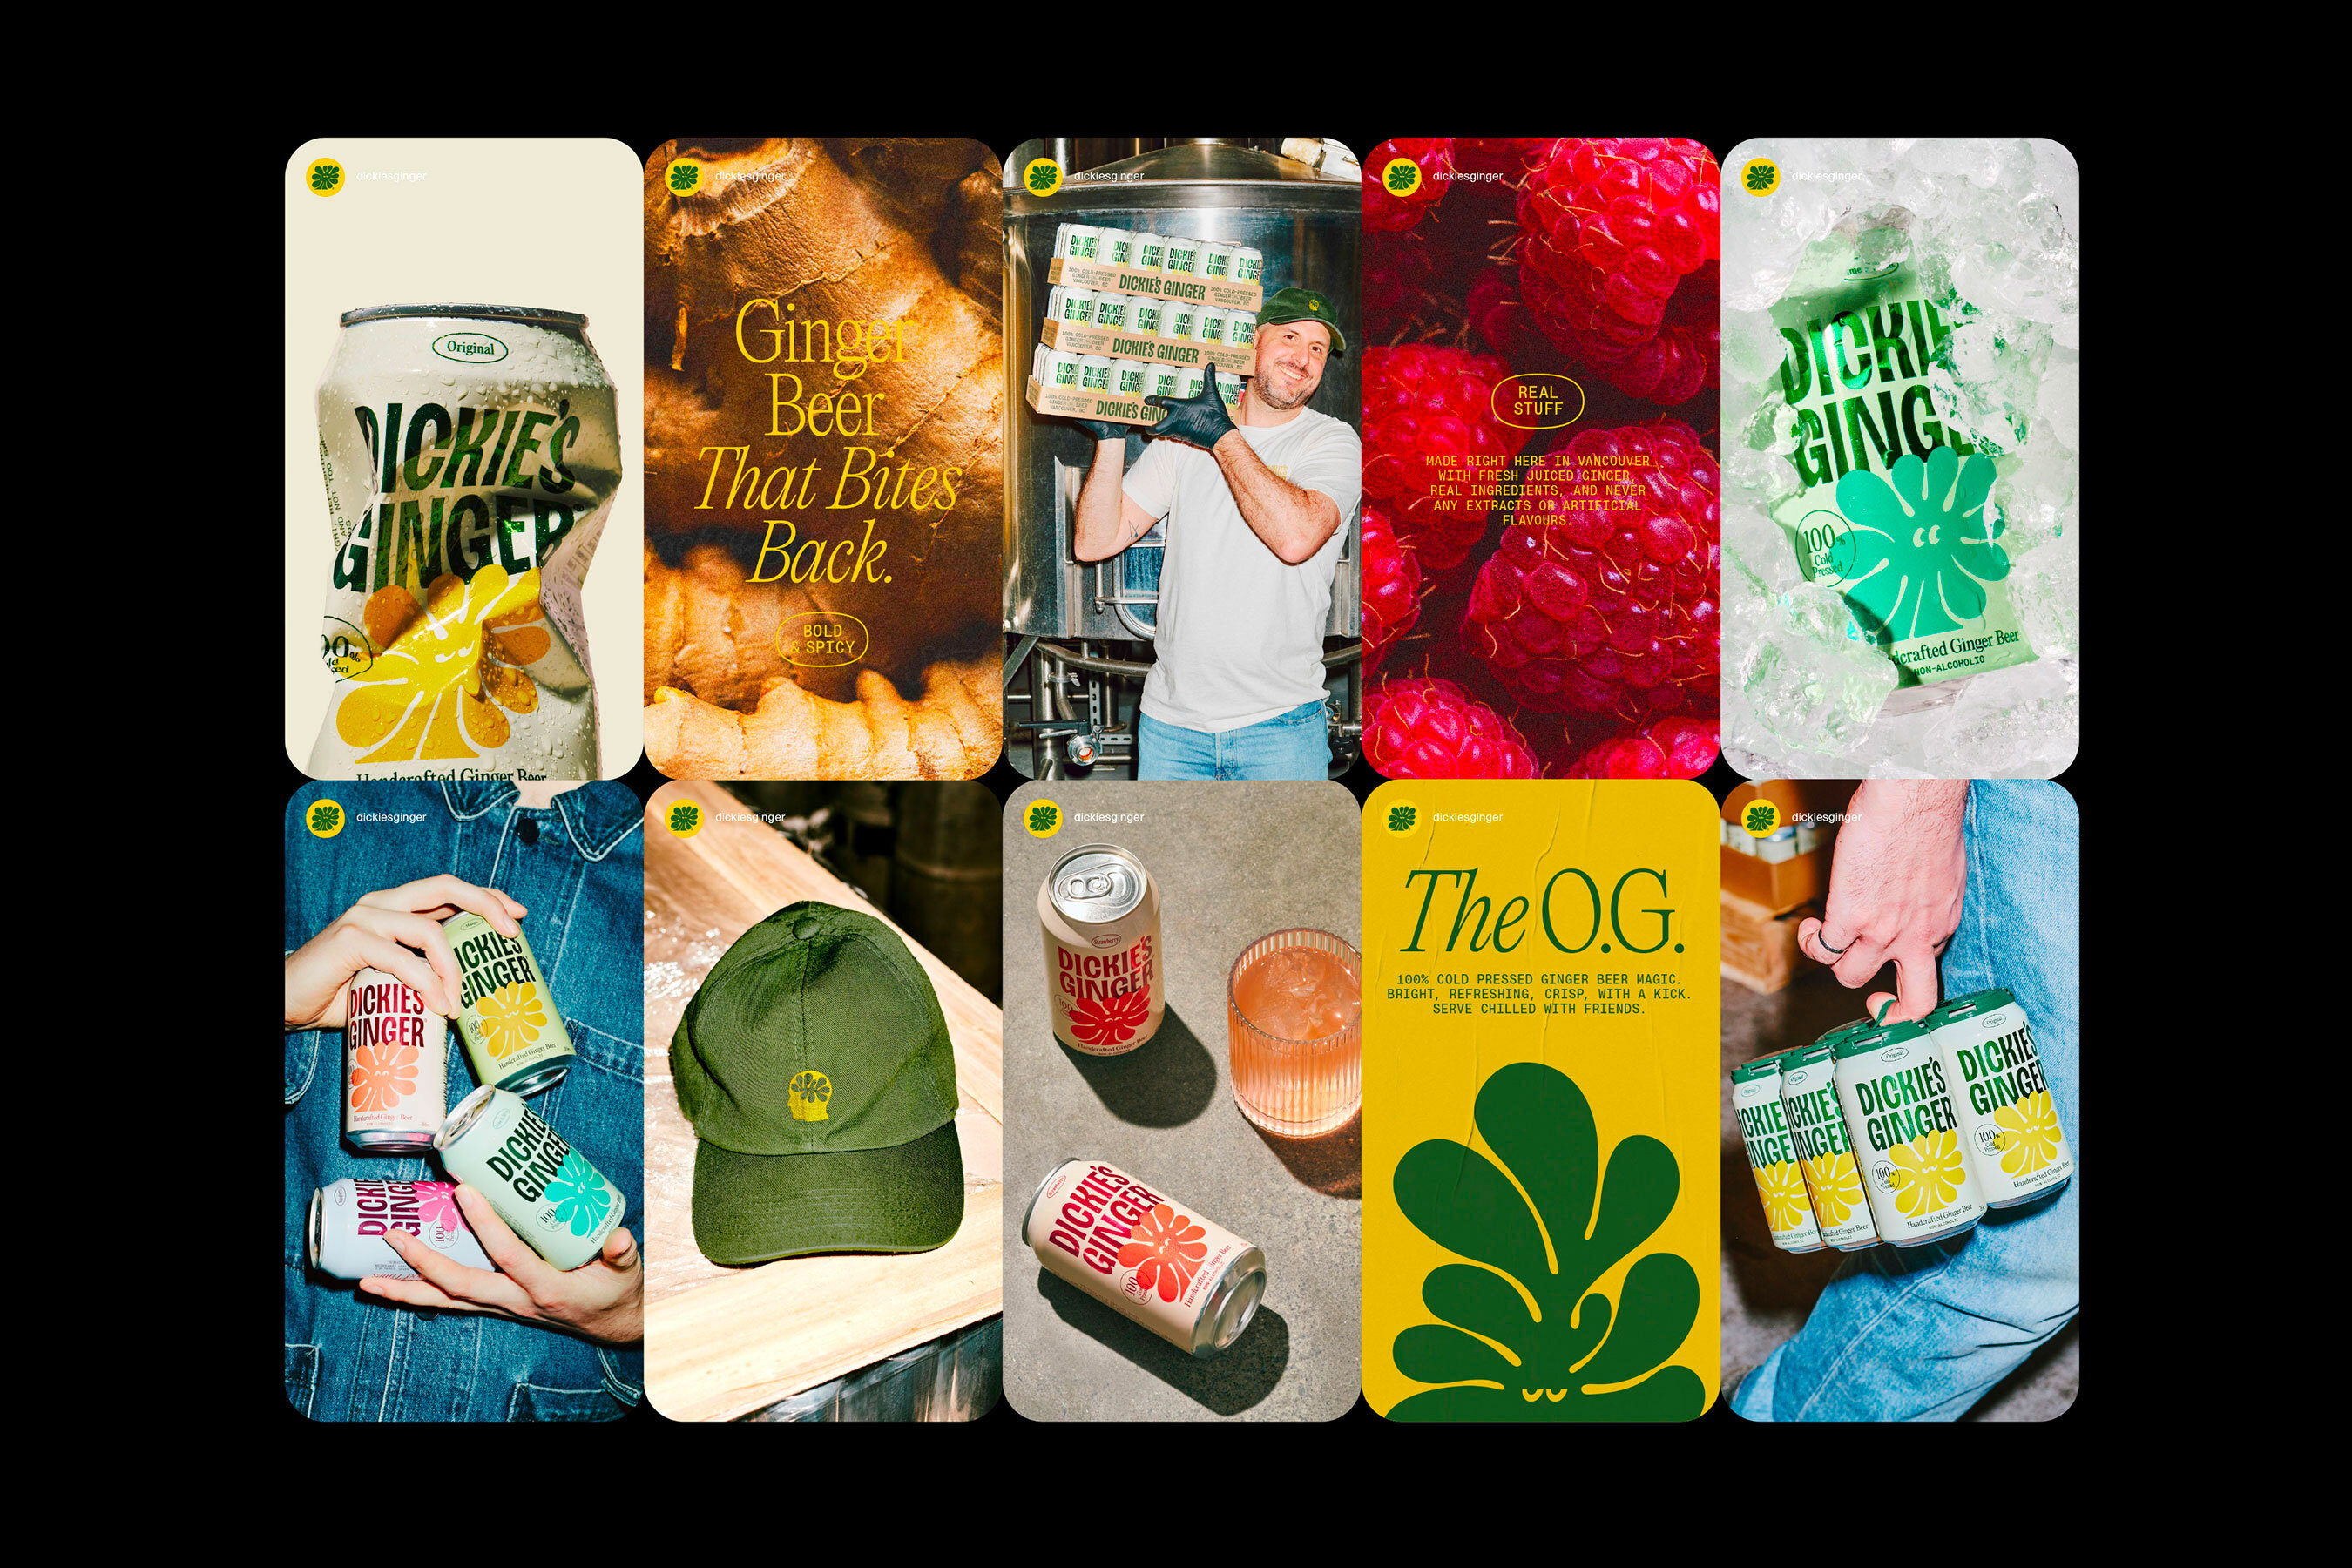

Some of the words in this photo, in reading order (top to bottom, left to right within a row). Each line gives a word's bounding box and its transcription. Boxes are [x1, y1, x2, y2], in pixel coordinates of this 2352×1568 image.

[1119, 274, 1162, 294] DICKIE'S
[1164, 280, 1206, 301] GINGER
[447, 340, 496, 356] Original
[1112, 338, 1155, 358] DICKIE'S
[1157, 344, 1200, 363] GINGER
[1096, 400, 1139, 419] DICKIE'S
[354, 399, 580, 494] DICKIE'S
[1803, 524, 1846, 555] 100%
[1812, 560, 1843, 578] Pressed
[1814, 551, 1834, 566] Cold
[1888, 641, 1949, 666] dcrafted
[1950, 638, 1994, 653] Ginger
[1994, 629, 2019, 645] Beer
[1914, 655, 1985, 677] NON-ALCOHOLIC
[1399, 867, 1530, 954] The
[1542, 868, 1685, 954] O.G.
[1093, 936, 1119, 945] Strawberry
[1057, 935, 1152, 979] DICKIE'S
[460, 956, 537, 1010] GINGER
[1059, 959, 1154, 1002] GINGER
[1387, 988, 1439, 1001] BRIGHT,
[1449, 988, 1534, 1001] REFRESHING,
[1544, 988, 1589, 1001] CRISP,
[1598, 988, 1630, 1001] WITH
[1638, 988, 1646, 1001] A
[1653, 988, 1692, 1001] KICK.
[1396, 974, 1429, 985] 100%
[1437, 974, 1469, 985] COLD
[1477, 974, 1533, 985] PRESSED
[1541, 974, 1589, 985] GINGER
[1597, 974, 1628, 985] BEER
[1637, 974, 1681, 985] MAGIC.
[350, 983, 425, 1019] DICKIES
[1433, 1003, 1472, 1014] SERVE
[1481, 1003, 1536, 1014] CHILLED
[1544, 1003, 1576, 1014] WITH
[1584, 1003, 1646, 1014] FRIENDS.
[349, 1017, 425, 1051] GINGER
[1078, 1043, 1115, 1052] Handcrafted
[1886, 1050, 1905, 1060] Original
[1957, 1022, 2038, 1083] DICKIE'S
[1855, 1057, 1946, 1116] DICKIE'S
[1970, 1059, 2050, 1116] GINGER
[1867, 1096, 1958, 1152] GINGER
[2013, 1171, 2048, 1188] Handcrafted
[1048, 1165, 1130, 1258] DICKIE'S
[1907, 1213, 1943, 1229] Handcrafted
[1083, 1185, 1165, 1275] GINGER
[1184, 1269, 1209, 1308] Handcrafted
